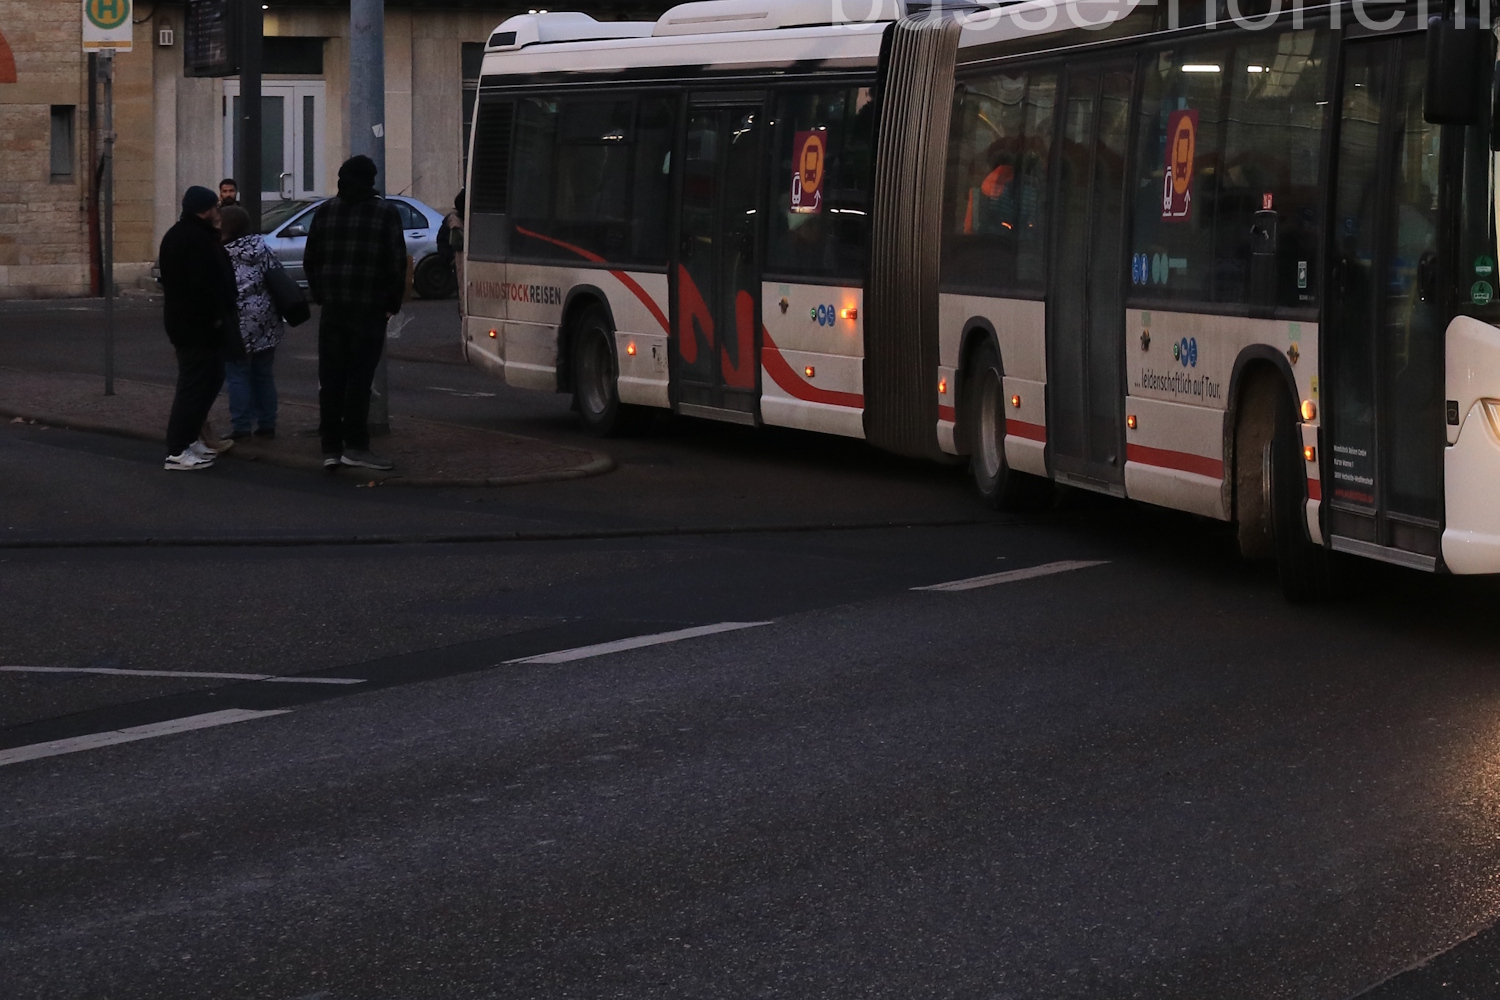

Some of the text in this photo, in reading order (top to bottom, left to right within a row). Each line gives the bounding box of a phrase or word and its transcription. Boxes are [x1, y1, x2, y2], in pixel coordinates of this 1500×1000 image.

[1141, 368, 1192, 397] leidenschaftlich
[1193, 375, 1205, 402] auf
[1205, 377, 1221, 399] Tour.
